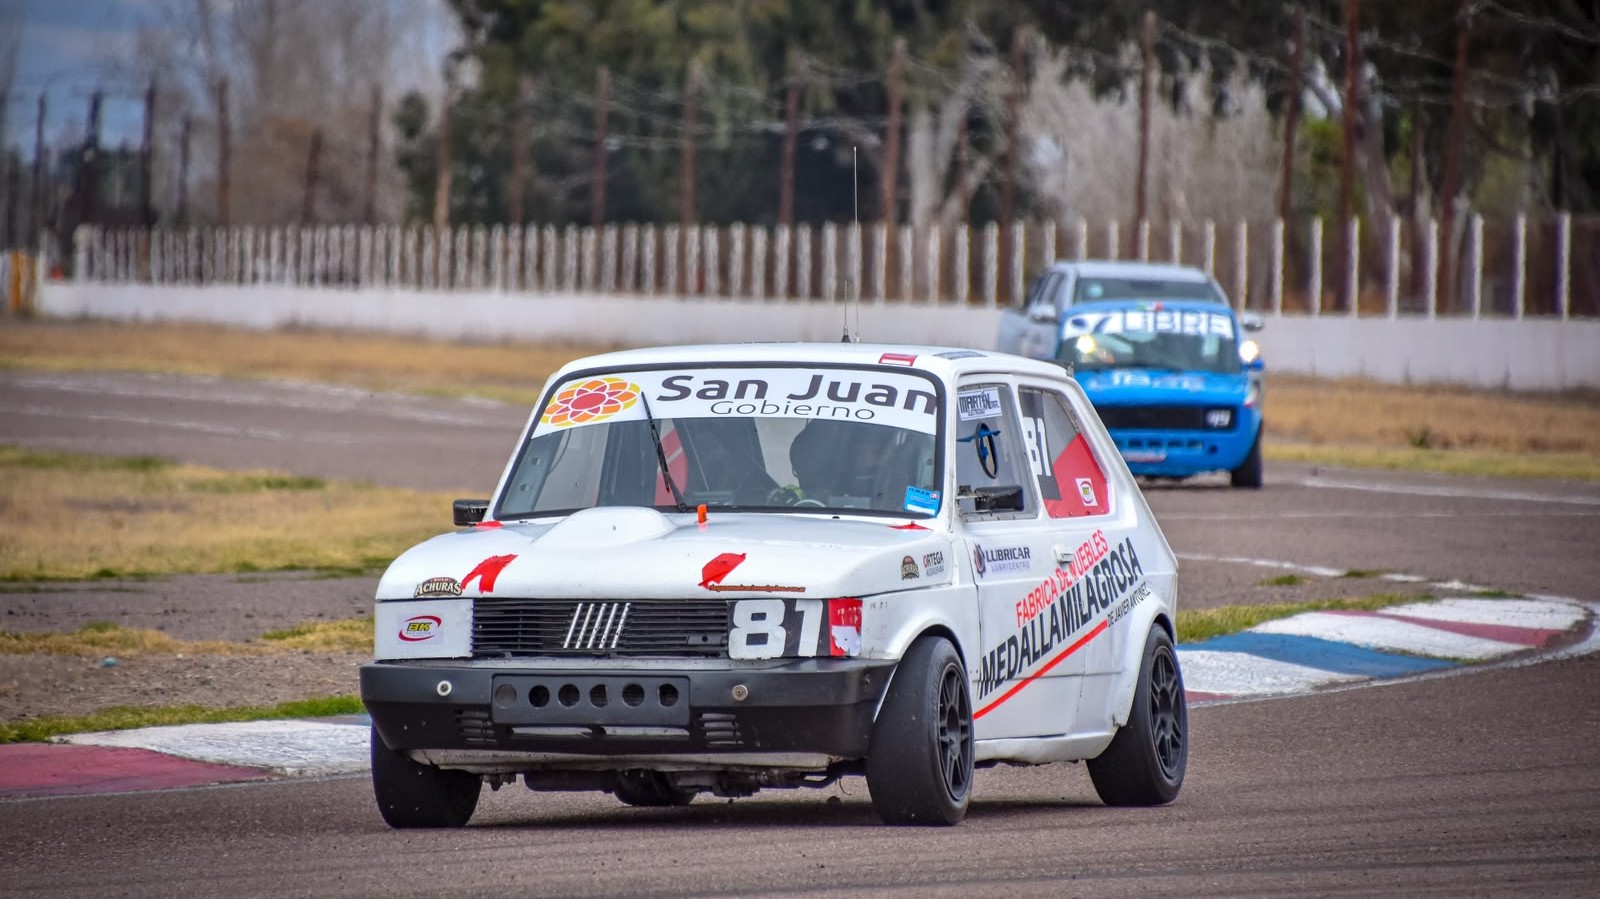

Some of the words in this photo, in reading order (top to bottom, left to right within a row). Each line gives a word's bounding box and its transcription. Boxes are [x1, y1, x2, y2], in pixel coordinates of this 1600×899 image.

[656, 375, 769, 401] San
[786, 374, 938, 415] Juan
[710, 400, 875, 420] Gobierno
[1021, 416, 1052, 477] 81
[923, 551, 944, 568] ORTEGA
[985, 546, 1031, 562] LUBRICAR
[413, 582, 463, 598] ACHURAS
[1015, 575, 1059, 628] FABRICA
[1056, 567, 1074, 592] DE
[728, 599, 824, 660] 81
